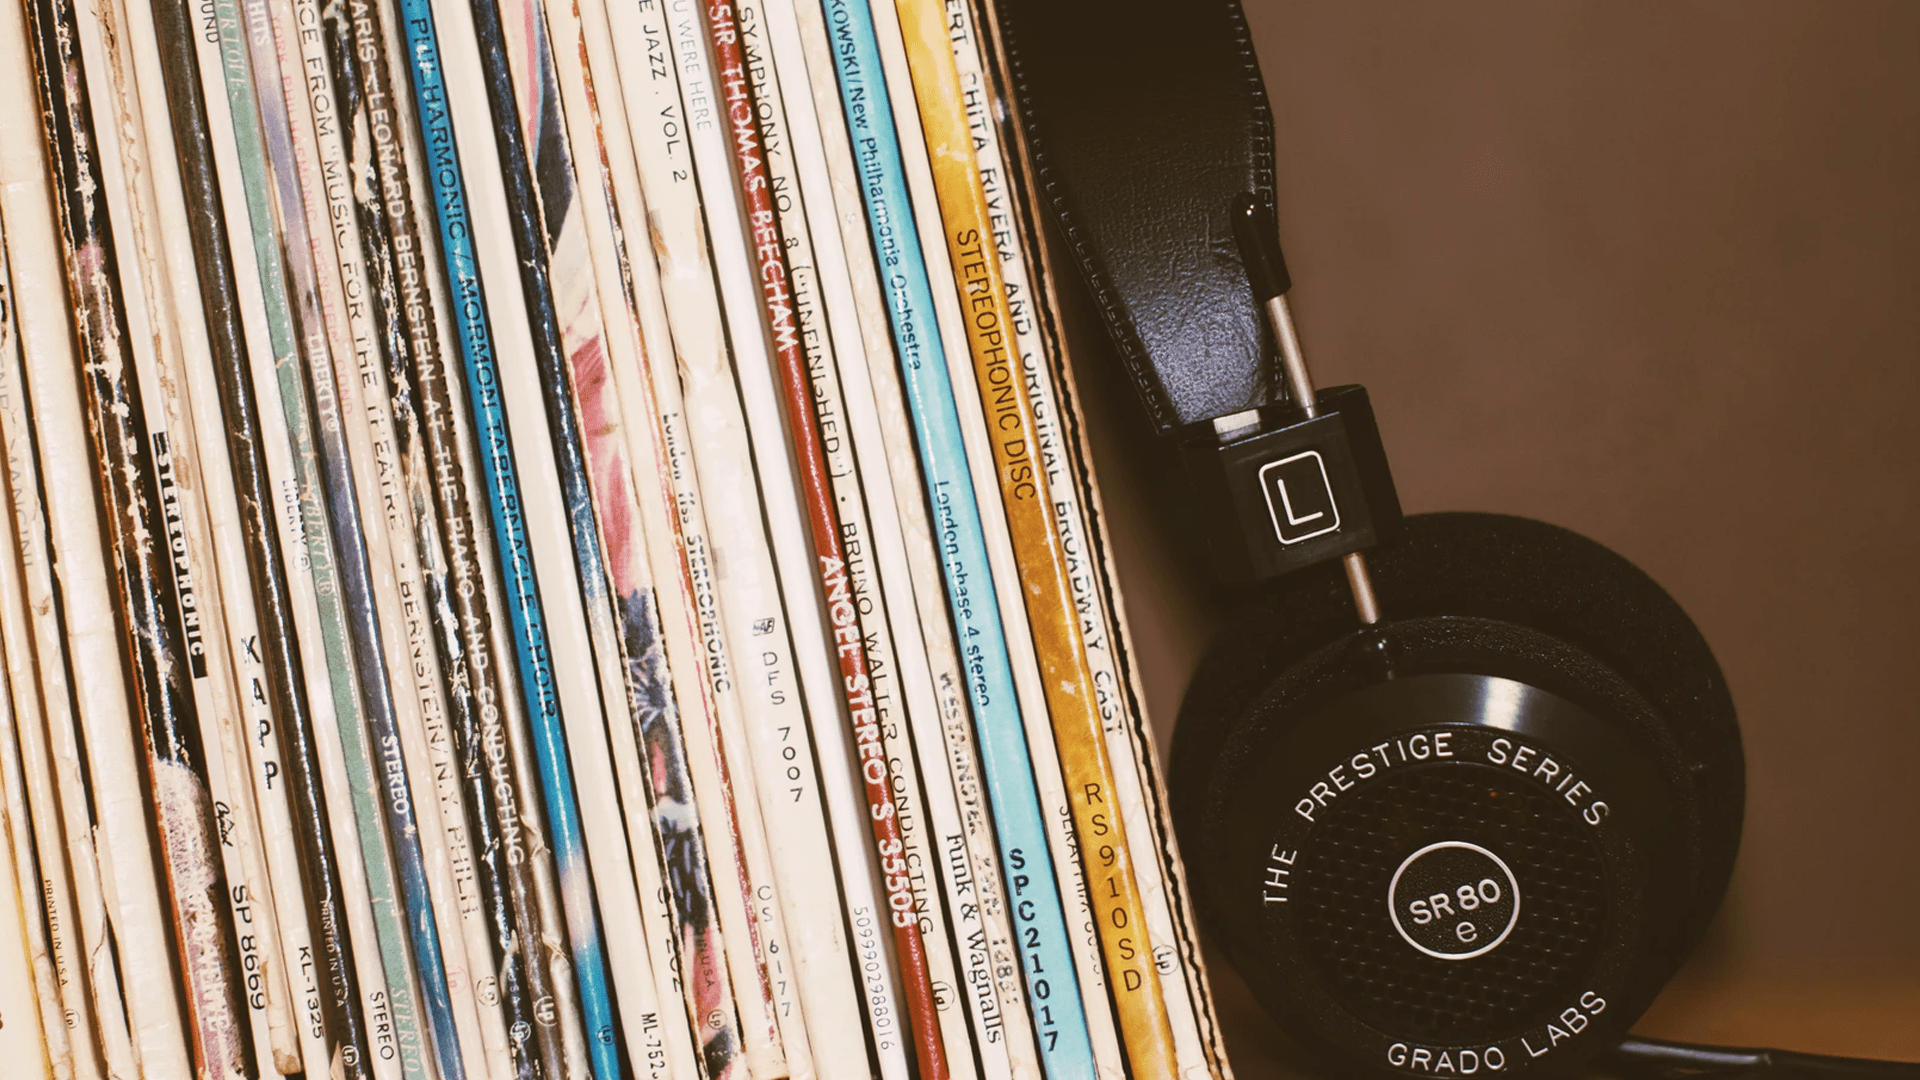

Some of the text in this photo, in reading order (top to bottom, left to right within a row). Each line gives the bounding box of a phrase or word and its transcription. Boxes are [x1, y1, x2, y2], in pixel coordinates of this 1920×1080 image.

[198, 0, 219, 45] UND
[248, 3, 270, 46] HITS
[675, 19, 701, 75] WERE
[688, 80, 711, 131] HERE
[641, 23, 666, 81] JAZZ
[658, 105, 682, 160] VOL.
[672, 169, 687, 183] 2
[305, 56, 333, 137] FROM
[341, 260, 365, 320] FOR
[354, 334, 377, 389] THE
[707, 4, 799, 352] SIR THOMAS BEECHAM
[392, 234, 437, 383] BERNSTEIN
[858, 137, 903, 268] Philharmonia
[889, 274, 925, 371] Orchestra
[410, 17, 466, 241] PHILHARMONIC
[456, 275, 498, 409] MORMON
[484, 418, 537, 611] TABERNACLE
[523, 621, 557, 718] CHOIR
[422, 397, 445, 433] AT
[955, 228, 1037, 501] STEREOPHONIC DISC
[432, 447, 458, 503] THE
[737, 6, 781, 157] SYMPHONY
[771, 175, 792, 219] NO.
[785, 236, 799, 249] 8
[841, 522, 873, 616] BRUNO
[863, 632, 899, 741] WALTER
[887, 757, 934, 935] CONDUCTING
[979, 167, 1015, 263] RIVERA
[1004, 280, 1032, 337] AND
[1020, 352, 1065, 485] ORIGINAL
[1054, 500, 1104, 653] BROADWAY
[1092, 669, 1123, 737] CAST
[1277, 479, 1323, 525] L
[156, 451, 204, 657] STEREOPHONIC
[443, 516, 476, 600] PIANO
[686, 534, 730, 693] STEREOPHONIC
[933, 481, 993, 707] London phase 4 stereo
[241, 635, 279, 789] KAPP
[462, 614, 489, 671] AND
[380, 734, 410, 815] STEREO
[475, 685, 525, 866] CONDUCTING
[818, 552, 917, 929] ANGEL STEREO S 35505
[1264, 732, 1610, 907] THE PRESTIGE SERIES
[231, 884, 251, 925] SP
[239, 934, 266, 1011] 8669
[944, 833, 1004, 1044] Funk & Wagnalls
[1456, 920, 1478, 942] e
[297, 946, 324, 1039] KL-1325
[369, 990, 395, 1061] STEREO
[388, 985, 421, 1074] STEREO
[641, 1012, 667, 1079] ML-752
[852, 906, 894, 1050] 5099902988016
[1387, 990, 1607, 1074] GRADO LABS
